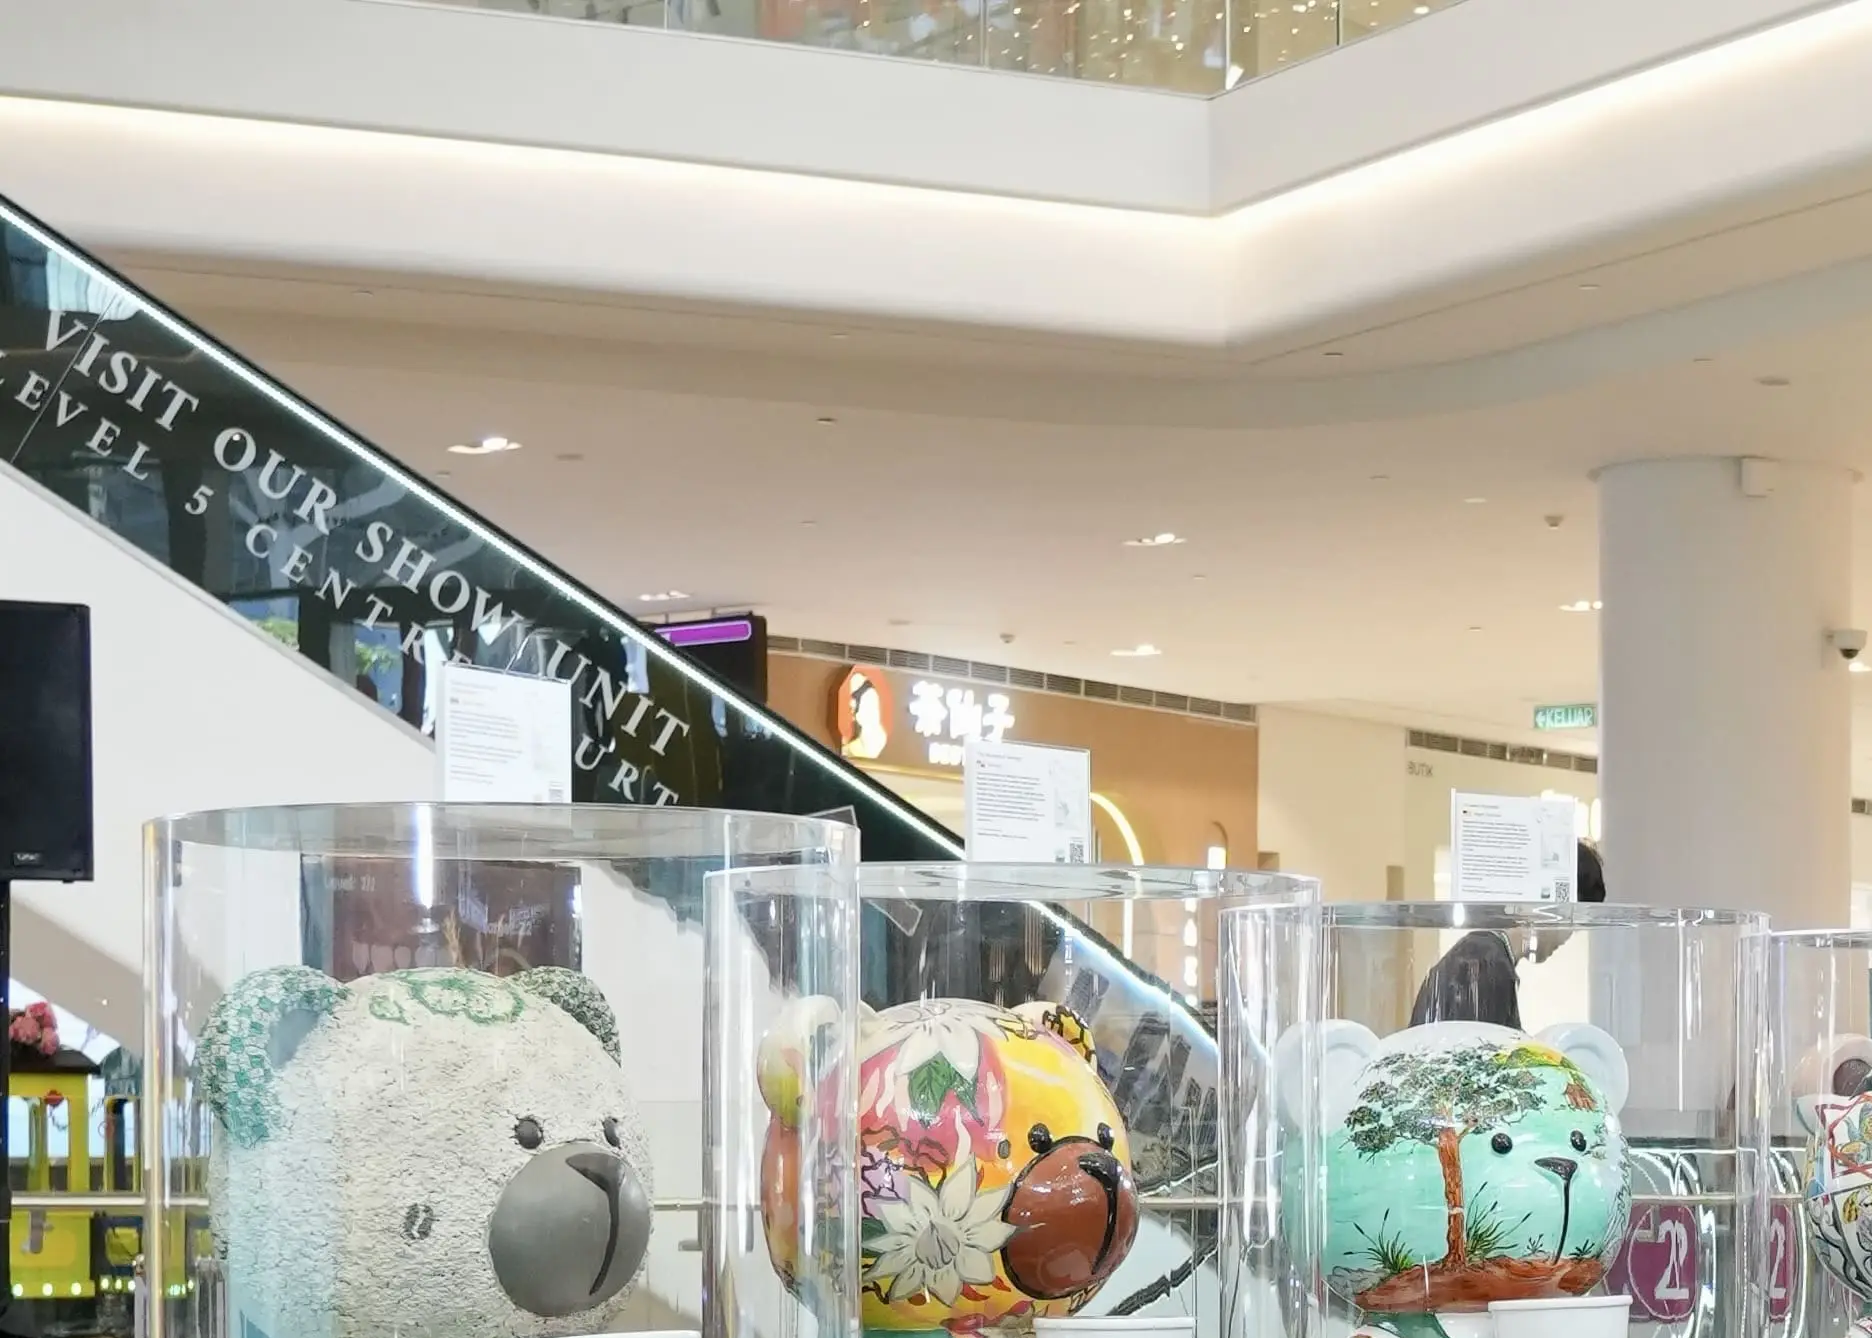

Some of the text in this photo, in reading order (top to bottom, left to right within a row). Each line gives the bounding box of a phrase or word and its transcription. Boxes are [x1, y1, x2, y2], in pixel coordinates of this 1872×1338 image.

[0, 352, 151, 481] EVEL
[185, 485, 215, 515] 5
[574, 733, 679, 808] URT
[46, 311, 199, 431] VISIT
[214, 428, 338, 535] OUR
[355, 520, 526, 646] SHOW
[547, 640, 690, 757] UNIT
[1547, 707, 1593, 726] KELUAR
